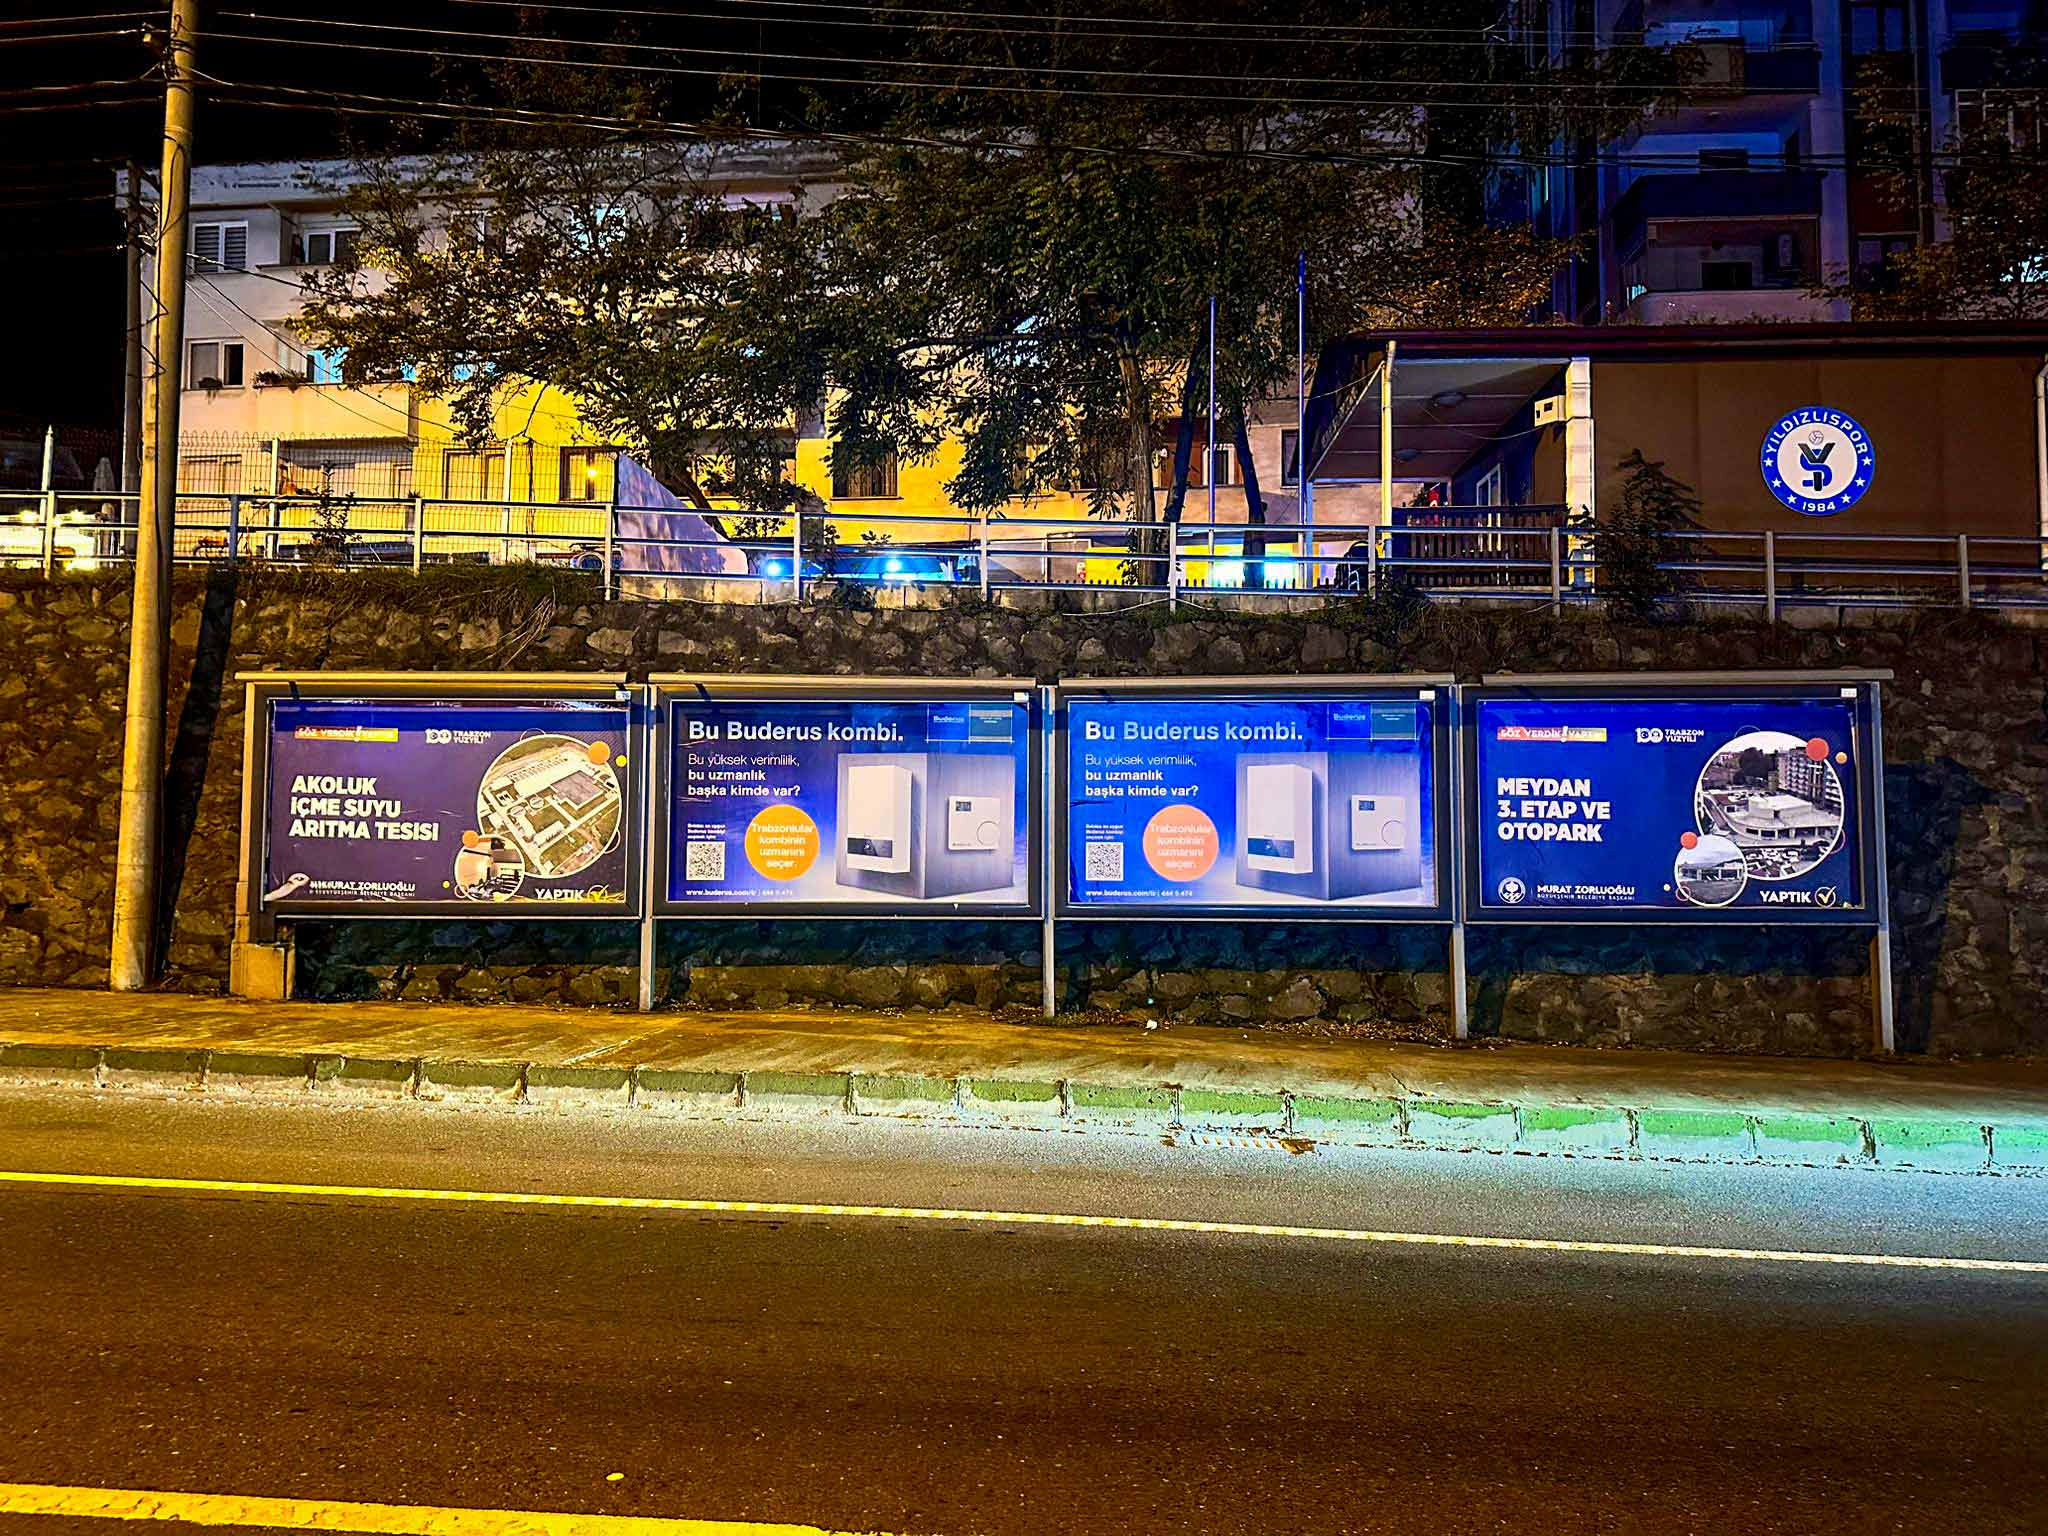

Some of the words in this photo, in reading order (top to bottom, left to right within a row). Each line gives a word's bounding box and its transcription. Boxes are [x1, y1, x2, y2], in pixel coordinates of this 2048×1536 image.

[1765, 410, 1868, 454] YILDIZLISPOR
[1802, 501, 1836, 512] 1984
[688, 721, 719, 740] Bu
[727, 721, 822, 741] Buderus
[827, 722, 904, 741] kombi.
[1085, 721, 1115, 740] Bu
[1124, 721, 1219, 740] Buderus
[1225, 721, 1303, 740] kombi.
[688, 754, 705, 765] Bu
[707, 753, 747, 768] yüksek
[751, 754, 800, 767] verimlilik,
[1085, 754, 1100, 766] Bu
[688, 770, 704, 780] bu
[708, 770, 766, 781] uzmanlık
[1085, 770, 1101, 780] bu
[1105, 770, 1163, 780] uzmanlık
[291, 775, 377, 796] AKOLUK
[688, 785, 727, 798] başka
[731, 785, 770, 796] kimde
[773, 785, 800, 796] var?
[1085, 785, 1124, 798] başka
[1127, 785, 1167, 796] kimde
[1171, 785, 1199, 796] var?
[1498, 778, 1591, 796] MEYDAN
[343, 799, 401, 818] SUYU
[1497, 800, 1517, 818] 3.
[1521, 800, 1577, 818] ETAP
[1581, 801, 1611, 819] VE
[288, 819, 371, 839] ARITMA
[1498, 821, 1602, 841] OTOPARK
[535, 888, 585, 900] YAPTIK
[1537, 885, 1572, 894] MURAT
[1575, 884, 1635, 895] ZORLUOĞLU
[1760, 890, 1812, 903] YAPTIK
